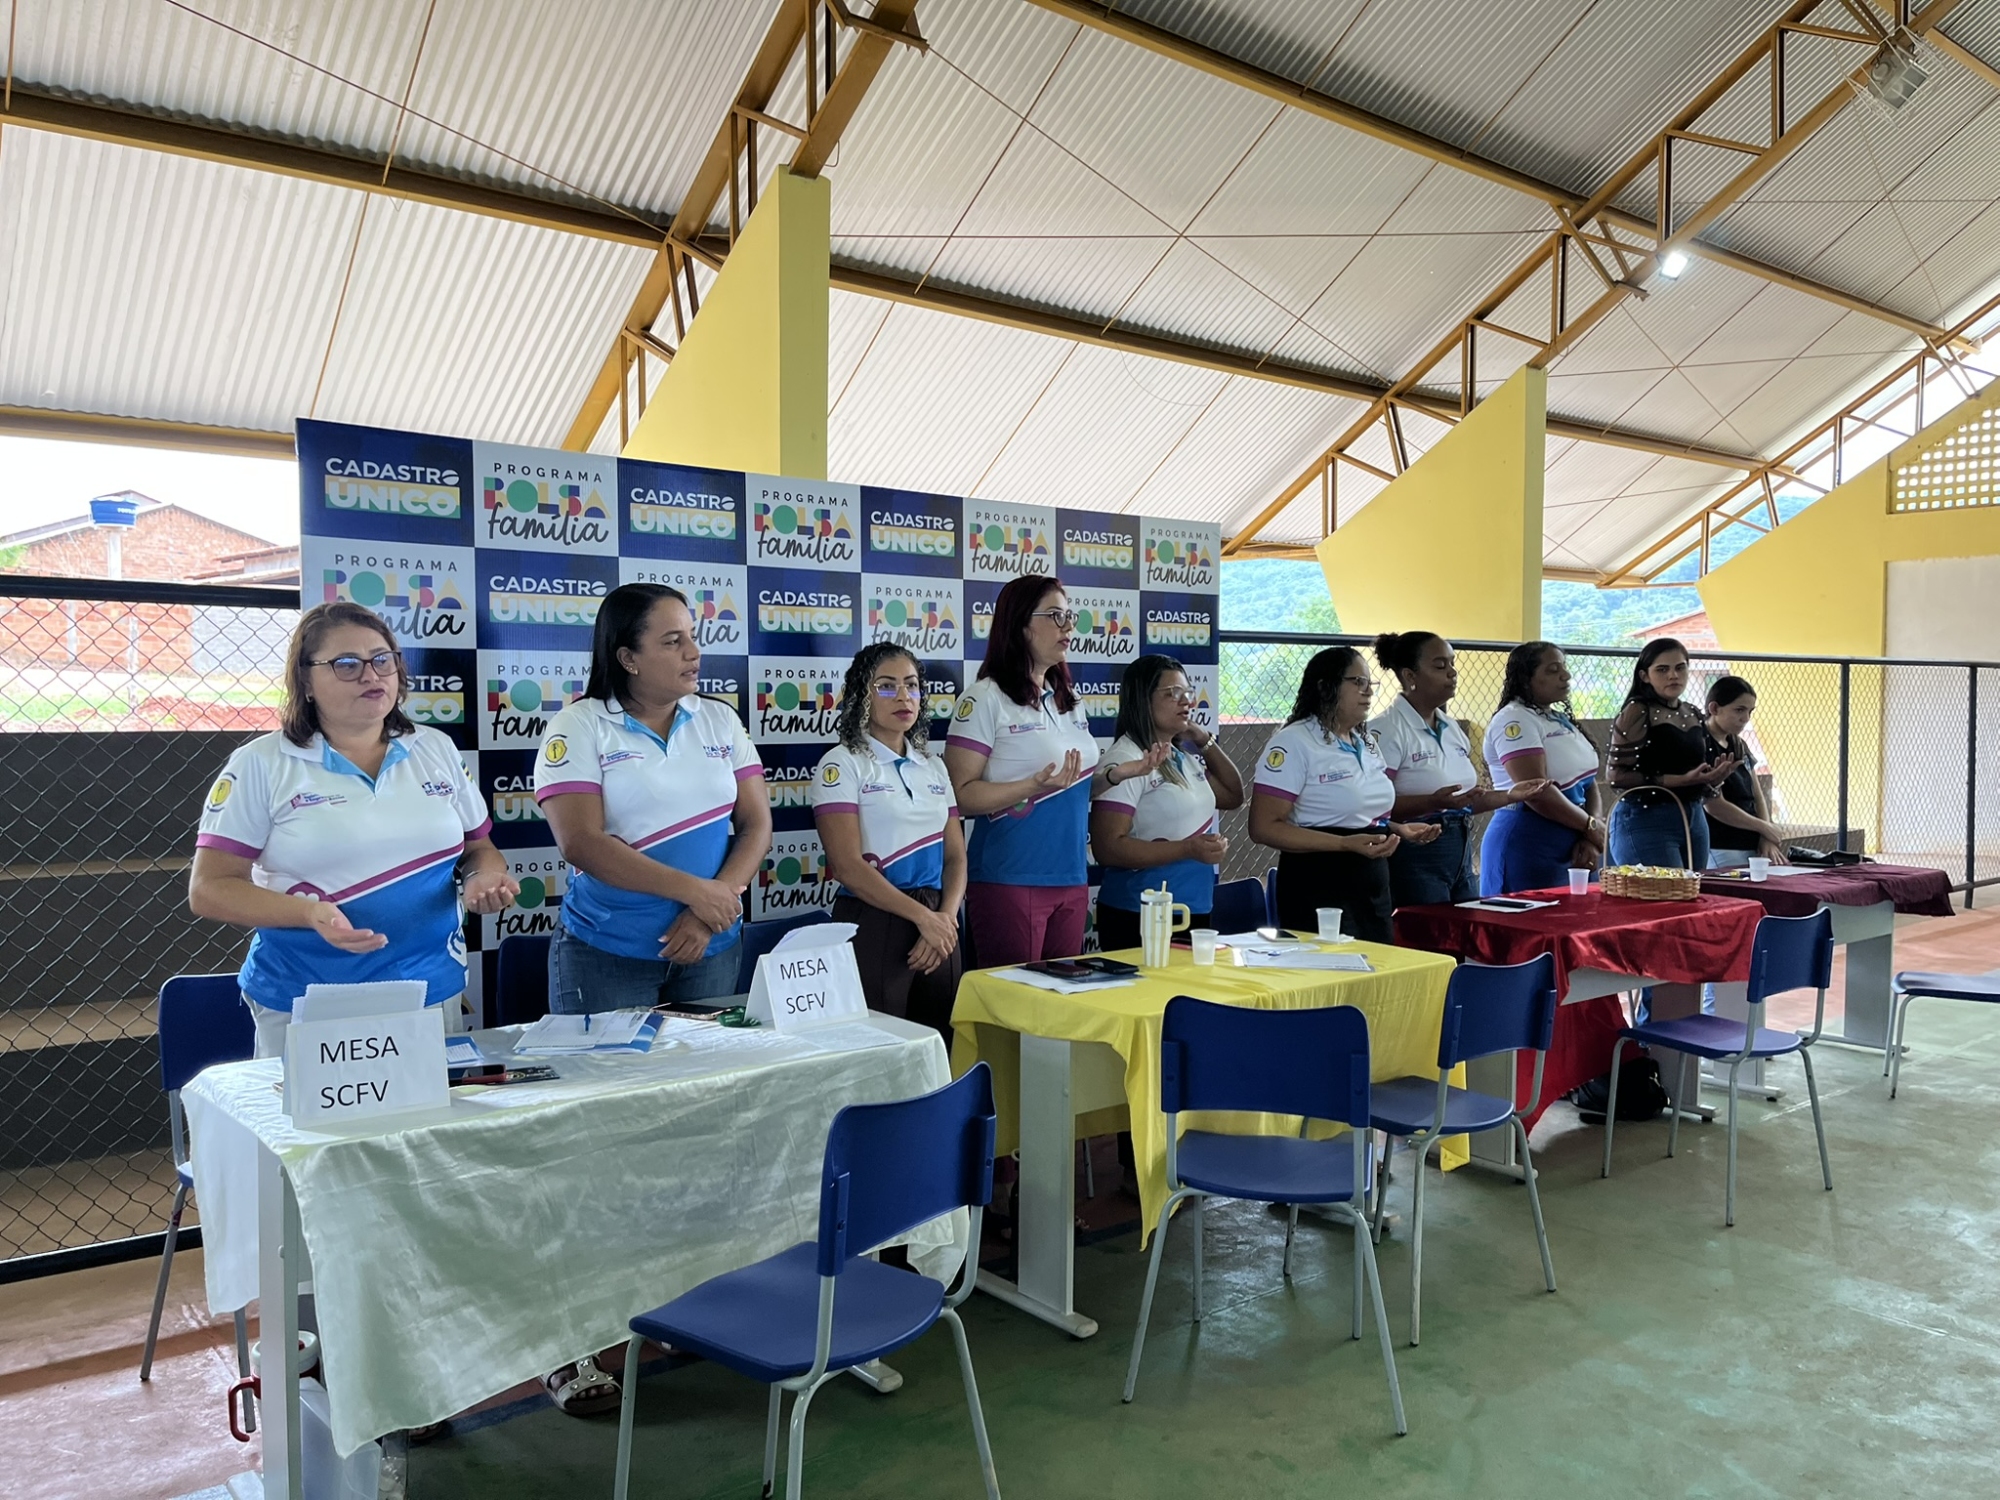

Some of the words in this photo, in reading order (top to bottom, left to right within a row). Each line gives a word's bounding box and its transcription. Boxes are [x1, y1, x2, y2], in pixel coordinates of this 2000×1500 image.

[326, 457, 460, 486] CADASTRO
[494, 462, 602, 483] PROGRAMA
[328, 478, 457, 516] ÚNICO
[484, 476, 612, 520] BOLSA
[631, 487, 735, 511] CADASTRO
[762, 489, 849, 507] PROGRAMA
[488, 501, 609, 546] família
[632, 505, 733, 538] ÚNICO
[754, 502, 856, 540] BOLSA
[870, 510, 955, 531] CADASTRO
[976, 511, 1046, 526] PROGRAMA
[758, 524, 854, 563] família
[872, 526, 951, 556] ÚNICO
[969, 522, 1051, 555] BOLSA
[1064, 529, 1133, 546] CADASTRO
[1151, 528, 1210, 541] PROGRAMA
[335, 554, 457, 572] PROGRAMA
[971, 543, 1050, 576] família
[1065, 544, 1131, 568] ÚNICO
[1145, 538, 1214, 567] BOLSA
[637, 572, 734, 587] PROGRAMA
[1147, 557, 1212, 587] família
[323, 569, 469, 610] BOLSA
[489, 575, 607, 596] CADASTRO
[876, 586, 952, 600] PROGRAMA
[758, 590, 852, 607] CADASTRO
[1067, 597, 1131, 609] PROGRAMA
[760, 607, 850, 633] ÚNICO
[868, 598, 959, 629] BOLSA
[1075, 608, 1136, 636] OLSA
[1147, 610, 1210, 624] CADASTRO
[1070, 630, 1134, 657] amília
[1148, 623, 1209, 646] ÚNICO
[498, 664, 591, 676] PROGRAM
[765, 669, 840, 679] PROGRAM
[406, 675, 464, 691] STRO
[1074, 682, 1121, 694] ADASTR
[487, 679, 584, 712] BOLS
[757, 682, 844, 711] BOLS
[1085, 698, 1119, 717] NIC
[760, 703, 842, 737] famíli
[764, 766, 817, 781] CADAS
[767, 783, 812, 808] ÚNI
[761, 877, 841, 914] famíli
[780, 958, 828, 980] MESA
[786, 991, 825, 1014] SCFV
[320, 1036, 399, 1064] MESA
[321, 1080, 389, 1109] SCFV
